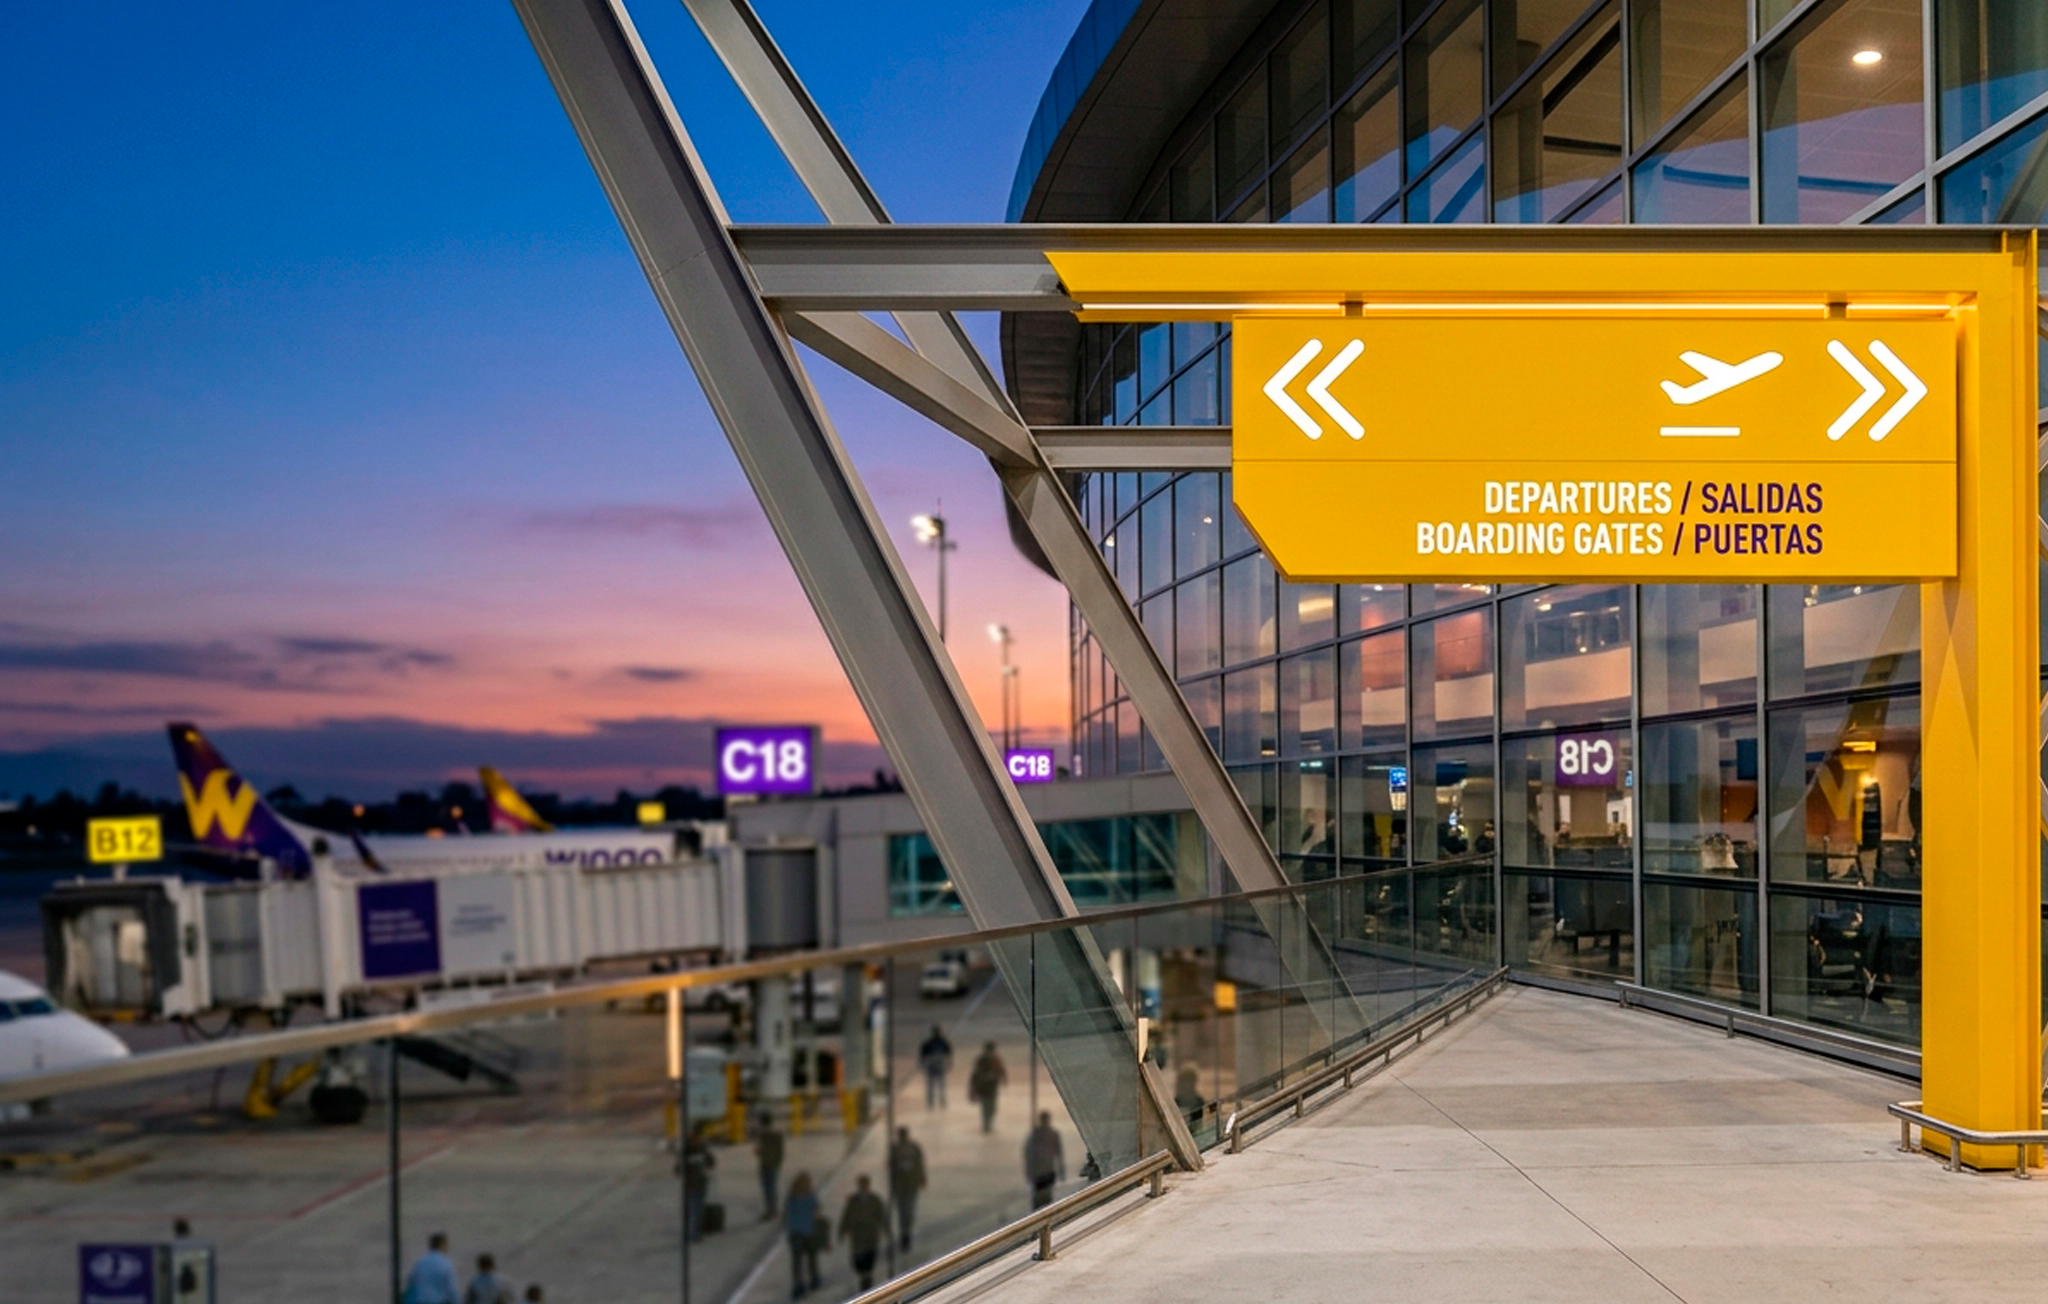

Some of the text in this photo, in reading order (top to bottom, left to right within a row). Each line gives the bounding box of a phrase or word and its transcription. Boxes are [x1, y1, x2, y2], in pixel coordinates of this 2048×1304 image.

[1484, 480, 1824, 516] DEPARTURES / SALIDAS
[1416, 521, 1824, 557] BOARDING GATES / PUERTAS
[722, 739, 806, 782] C18
[1008, 754, 1051, 777] C18
[95, 826, 156, 855] B12
